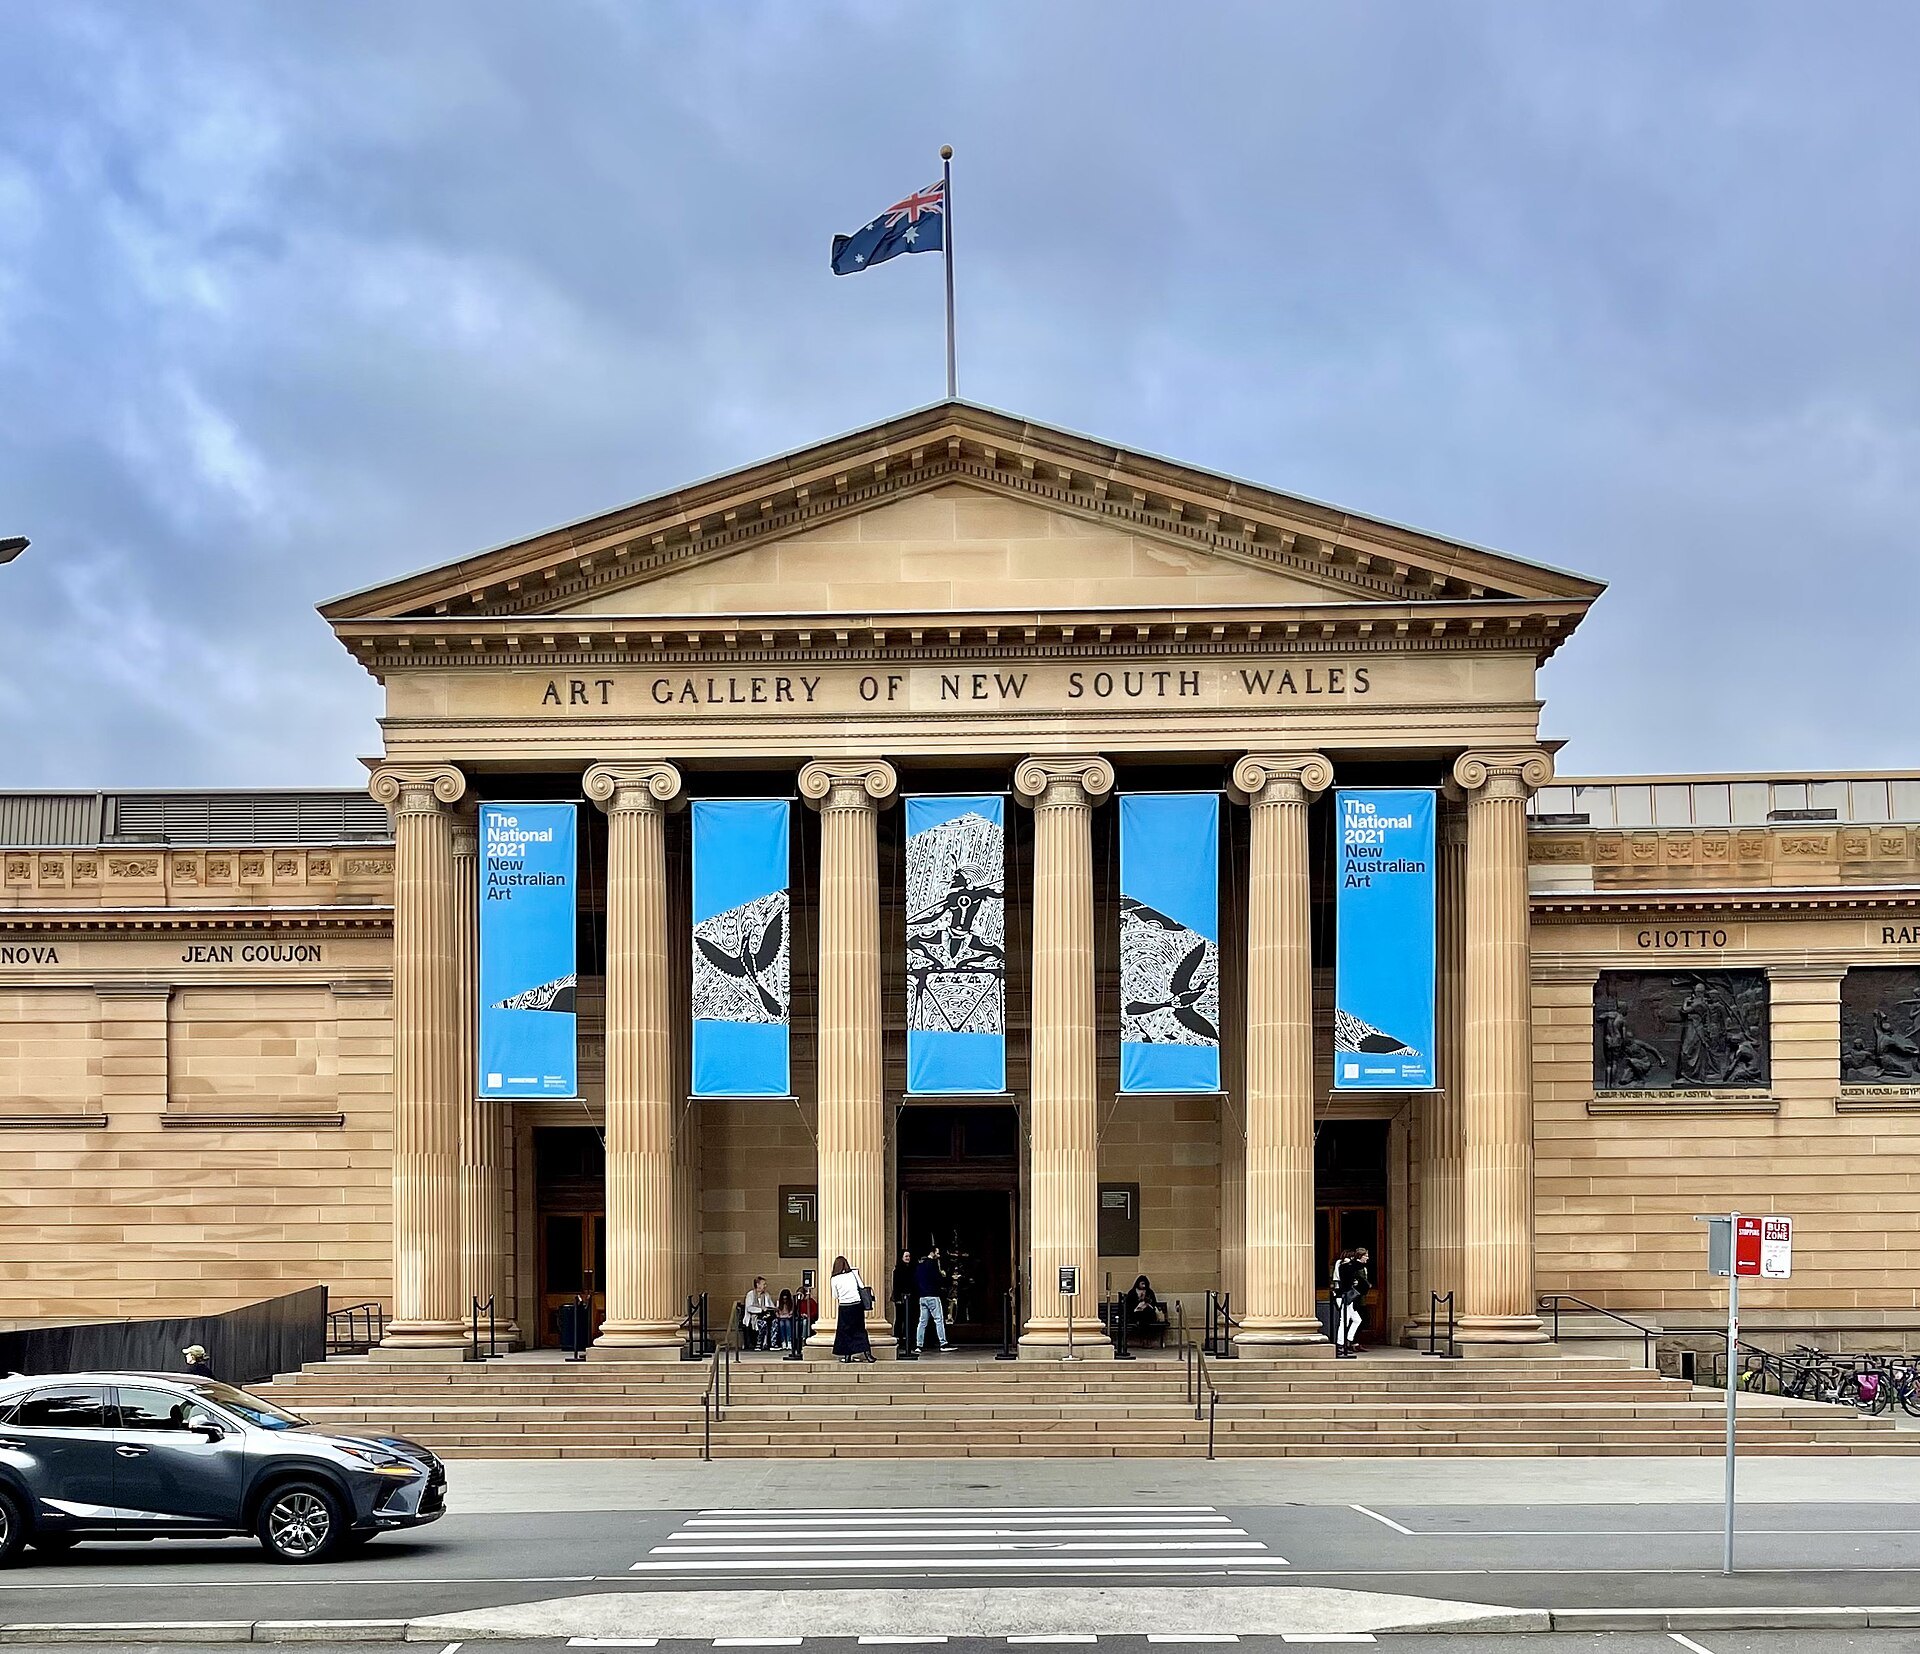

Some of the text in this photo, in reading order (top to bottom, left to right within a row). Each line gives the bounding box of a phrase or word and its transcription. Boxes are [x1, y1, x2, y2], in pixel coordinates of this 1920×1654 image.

[542, 667, 1370, 705] ART GALLERY OF NEW SOUTH WALES
[1344, 799, 1376, 814] The
[487, 813, 518, 827] The
[1345, 814, 1412, 828] National
[487, 828, 553, 841] National
[1344, 829, 1385, 844] 2021
[487, 843, 526, 856] 2021
[1345, 844, 1383, 858] New
[488, 857, 524, 871] New
[1345, 859, 1426, 873] Australian
[487, 872, 566, 886] Australian
[1345, 874, 1371, 888] Art
[487, 886, 512, 900] Art
[1637, 929, 1728, 948] GIOTTO
[1, 946, 59, 964] NOVA
[181, 944, 322, 963] JEAN GOUJON
[1767, 1223, 1788, 1232] BUS
[1766, 1231, 1788, 1240] ZONE
